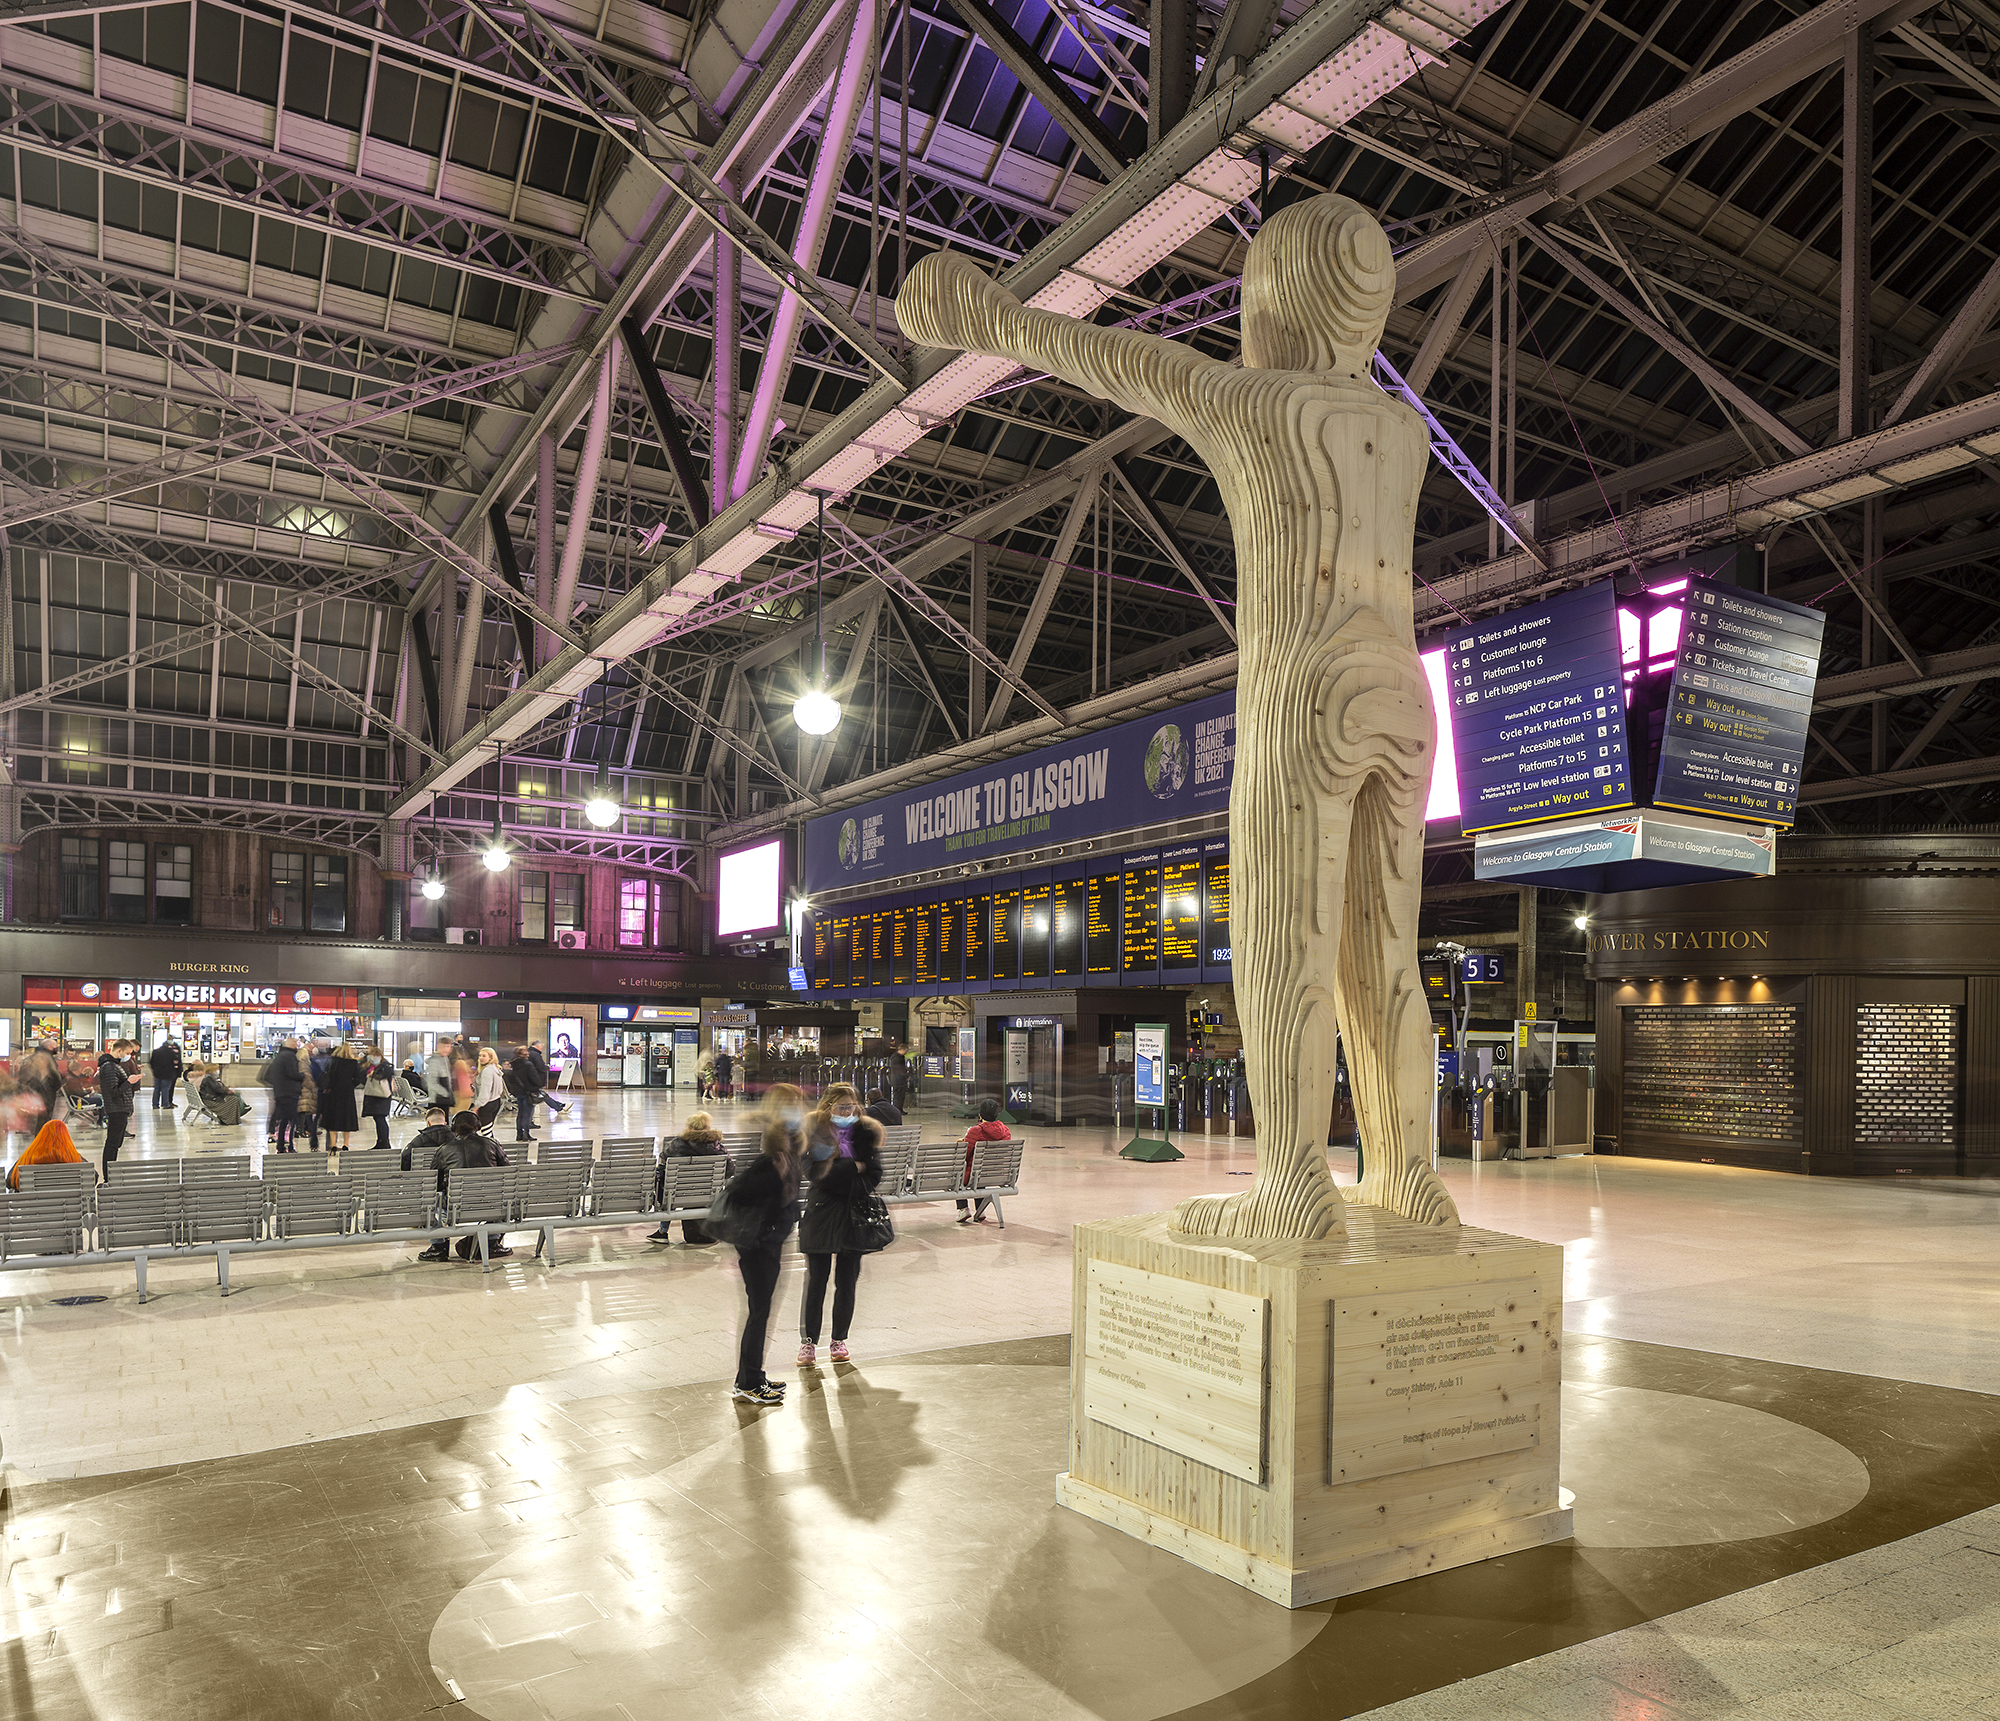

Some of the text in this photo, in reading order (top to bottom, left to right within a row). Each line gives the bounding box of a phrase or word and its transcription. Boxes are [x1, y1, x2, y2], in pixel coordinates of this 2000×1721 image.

[1722, 598, 1783, 624] Toilets and showers
[1478, 616, 1551, 644] Toilets and showers
[1718, 619, 1772, 642] Station reception
[1481, 637, 1547, 662] Customer lounge
[1715, 639, 1769, 662] Customer lounge
[1483, 655, 1543, 681] Platforms 1 to 6
[1712, 658, 1790, 686] Tickets and Travel Centre
[1484, 670, 1571, 699] Left luggage Lost property
[1712, 679, 1728, 692] Taxis
[1730, 683, 1742, 695] and
[1744, 685, 1770, 702] Glasgow
[1772, 693, 1793, 707] Station
[1505, 712, 1523, 721] Platform
[1530, 703, 1546, 716] NCP
[1548, 700, 1562, 710] Car
[1564, 694, 1582, 707] Park
[1706, 698, 1768, 723] Way out Union Street
[1196, 721, 1206, 738] UN
[1500, 710, 1592, 741] Cycle Park Platform 15
[1703, 718, 1769, 735] Way out Gordon Street
[1195, 732, 1225, 754] CHANGE
[1482, 732, 1584, 764] Changing places Accessible toilet
[1519, 750, 1587, 773] Platforms 7 to 15
[1722, 752, 1773, 771] Accessible toilet
[1195, 763, 1224, 784] UK 2021
[1523, 770, 1590, 791] Low level station
[1721, 772, 1772, 789] Low level station
[905, 748, 1110, 845] WELCOME TO GLASGOW
[1508, 803, 1522, 813] Argyle
[1553, 793, 1571, 805] Way
[1574, 789, 1590, 801] out
[1704, 792, 1716, 800] Argyle
[1741, 794, 1755, 808] Way
[1756, 797, 1768, 808] out
[946, 814, 1050, 852] THANK YOU FOR TRAVELLING BY TRAIN
[1205, 842, 1225, 851] Information
[1482, 841, 1612, 866] Welcome to Glasgow Central Station
[1650, 836, 1755, 860] Welcome to Glasgow Central Station
[1653, 930, 1769, 950] STATION
[170, 963, 249, 974] BURGER KING
[1468, 959, 1498, 977] 5 5
[118, 983, 277, 1005] BURGER KING
[630, 978, 648, 986] Left
[650, 979, 682, 990] luggage
[750, 982, 788, 991] Customer
[1216, 1015, 1219, 1024] 1
[1456, 1376, 1463, 1386] 11
[1462, 1424, 1472, 1434] by
